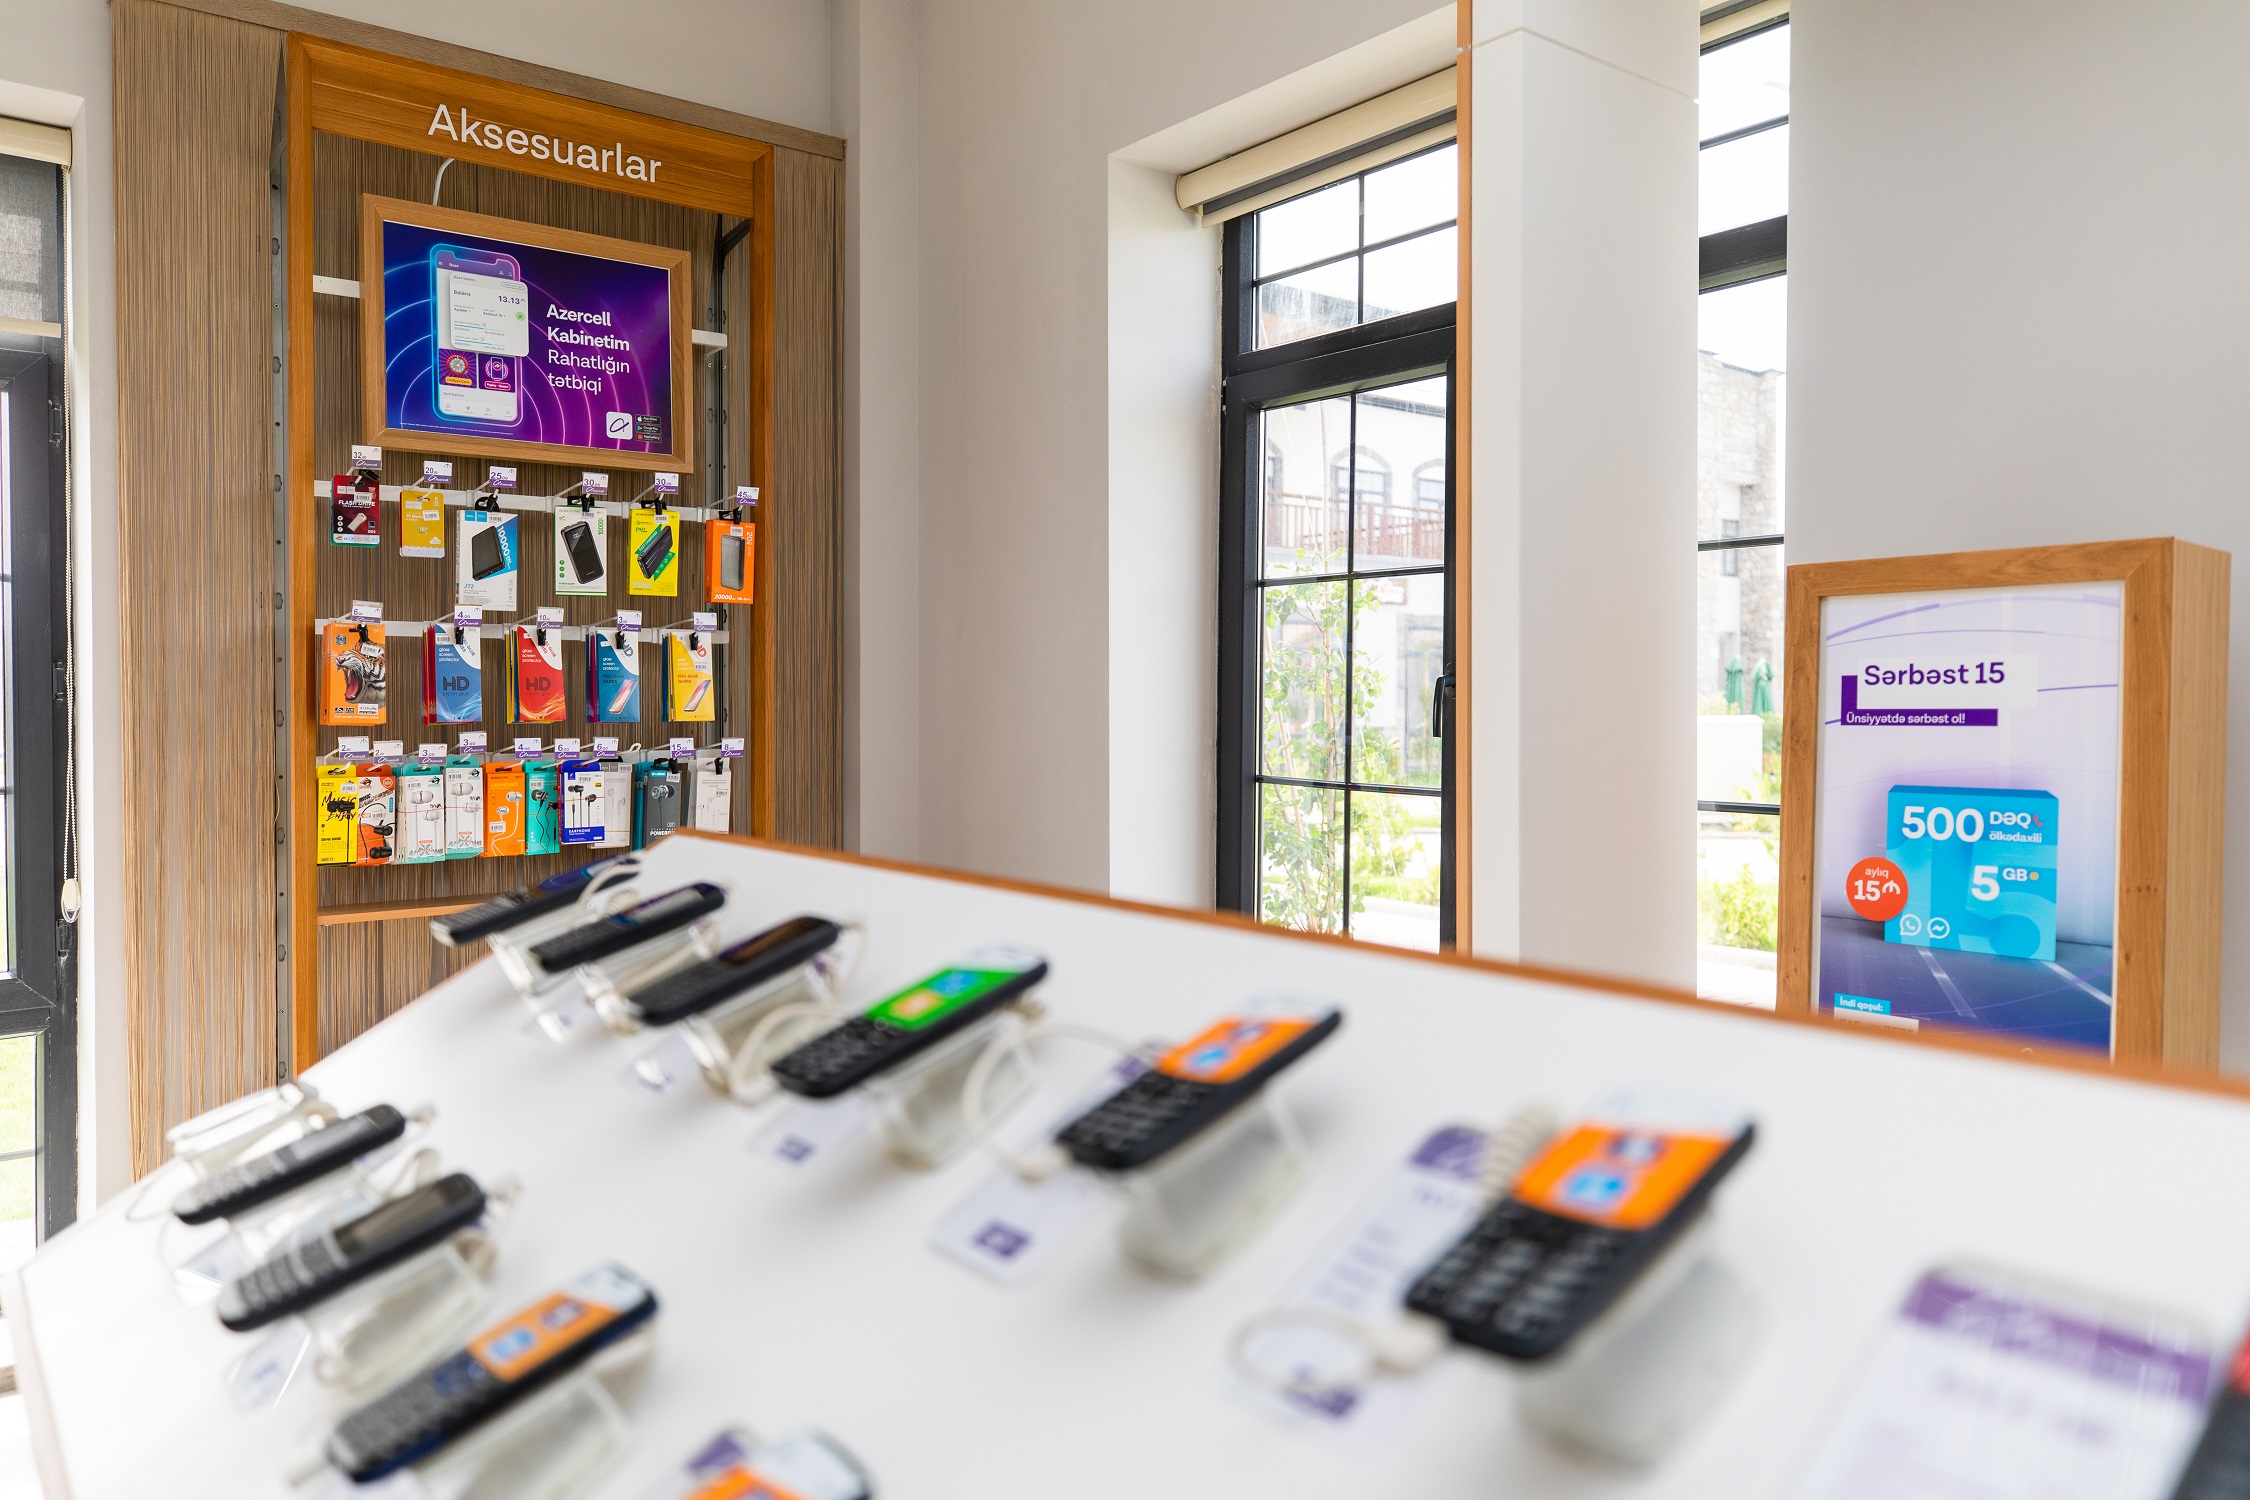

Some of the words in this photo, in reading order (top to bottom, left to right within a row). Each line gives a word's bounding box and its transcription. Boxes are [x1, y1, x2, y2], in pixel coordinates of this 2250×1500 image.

[428, 104, 661, 183] Aksesuarlar
[547, 304, 611, 326] Azercell
[547, 326, 630, 351] Kabinetim
[548, 349, 630, 375] Rahatlığın
[548, 372, 601, 395] tətbiqi
[443, 676, 470, 691] HD
[526, 677, 551, 691] HD
[1864, 663, 1969, 686] Sərbəst
[1975, 662, 2005, 684] 15
[1846, 711, 1906, 725] Ünsiyyətdə
[1907, 713, 1949, 724] sərbəst
[1951, 712, 1966, 724] ol!
[1902, 805, 1984, 843] 500
[1990, 811, 2031, 829] DƏQ
[1989, 830, 2042, 844] ölkədaxili
[1865, 867, 1889, 879] aylıq
[1970, 864, 2000, 901] 5
[2002, 868, 2028, 882] GB
[1840, 996, 1856, 1008] İndi
